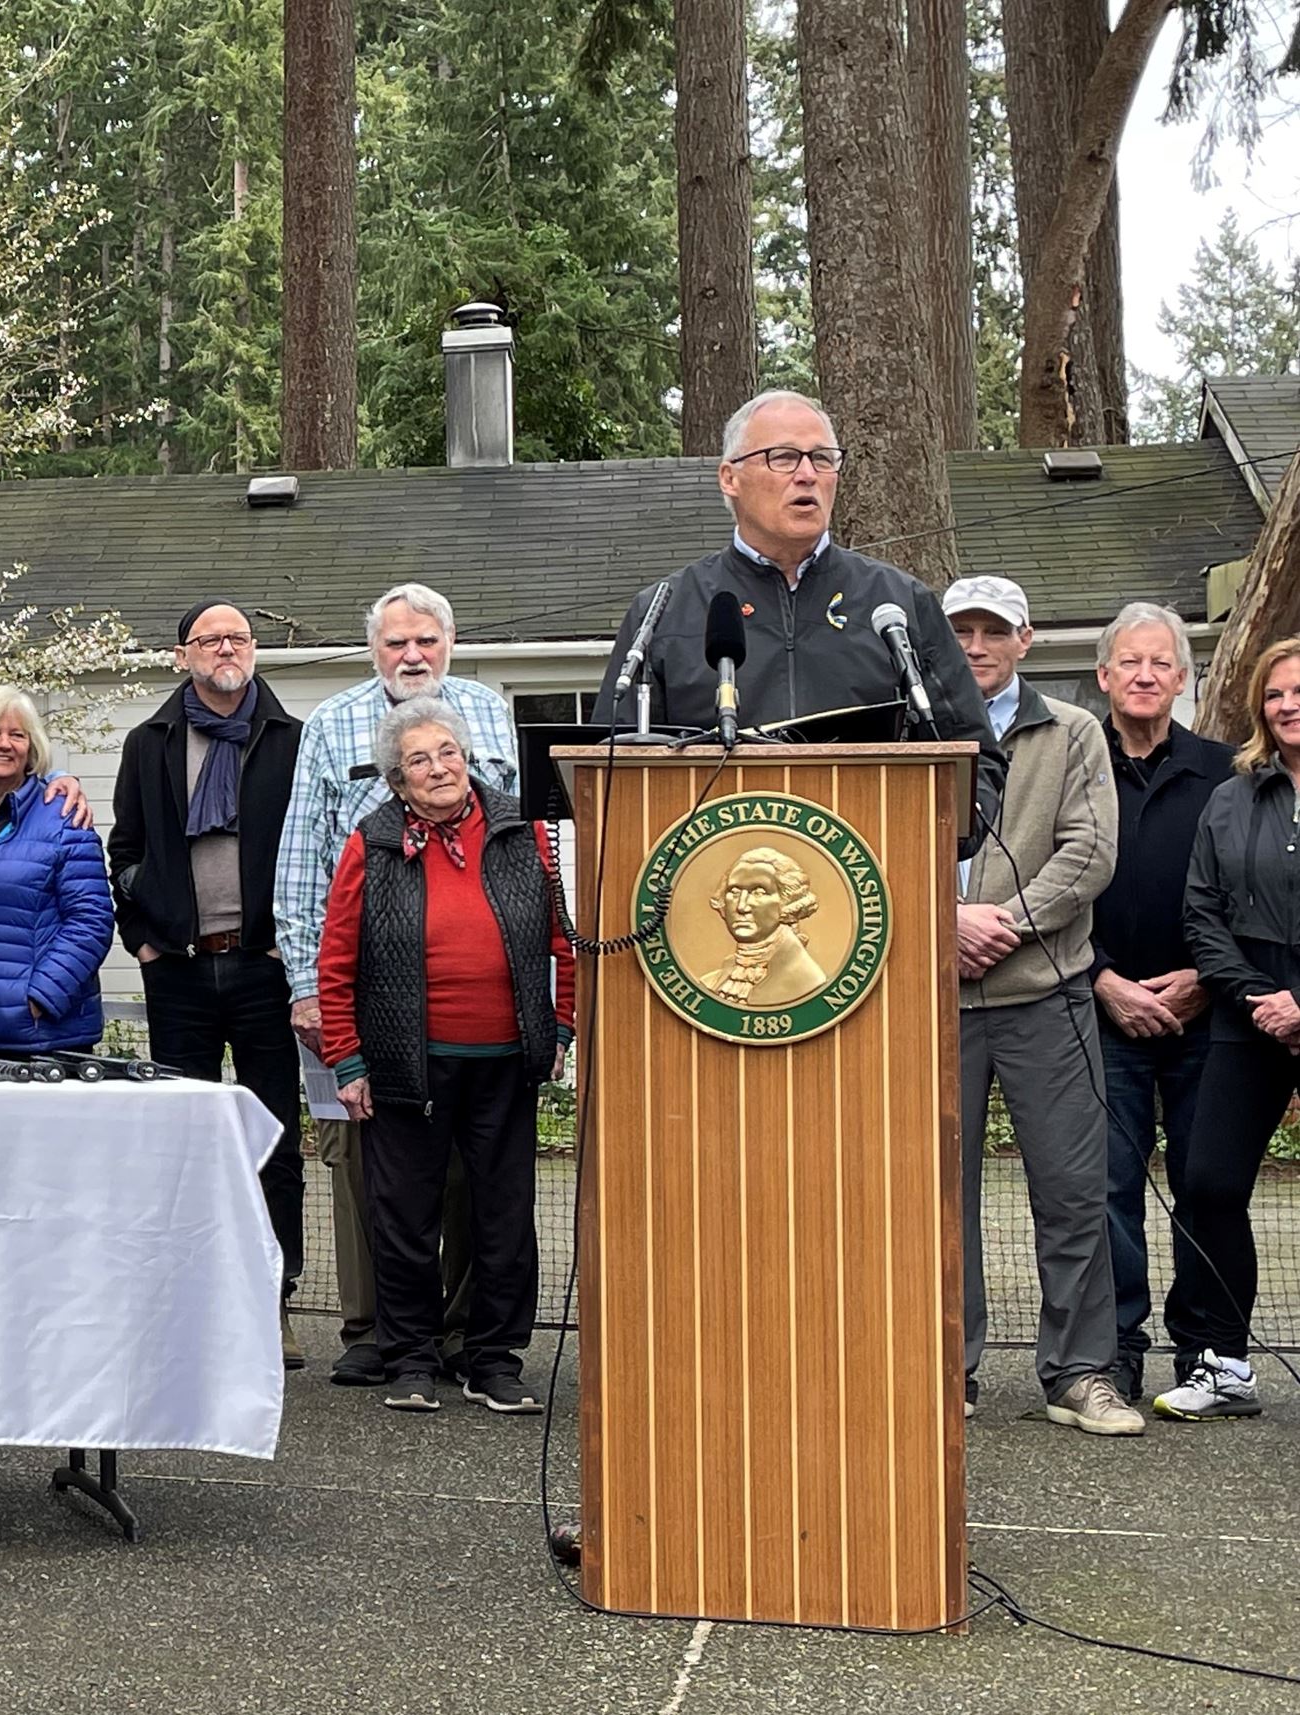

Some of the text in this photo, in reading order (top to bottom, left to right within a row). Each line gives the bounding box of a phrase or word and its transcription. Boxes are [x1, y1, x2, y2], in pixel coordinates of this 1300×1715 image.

[718, 802, 802, 828] STATE
[806, 815, 844, 845] OF
[664, 815, 716, 857] THE
[823, 839, 883, 1012] WASHINGTON
[658, 965, 704, 1014] THE
[739, 1014, 793, 1036] 1889
